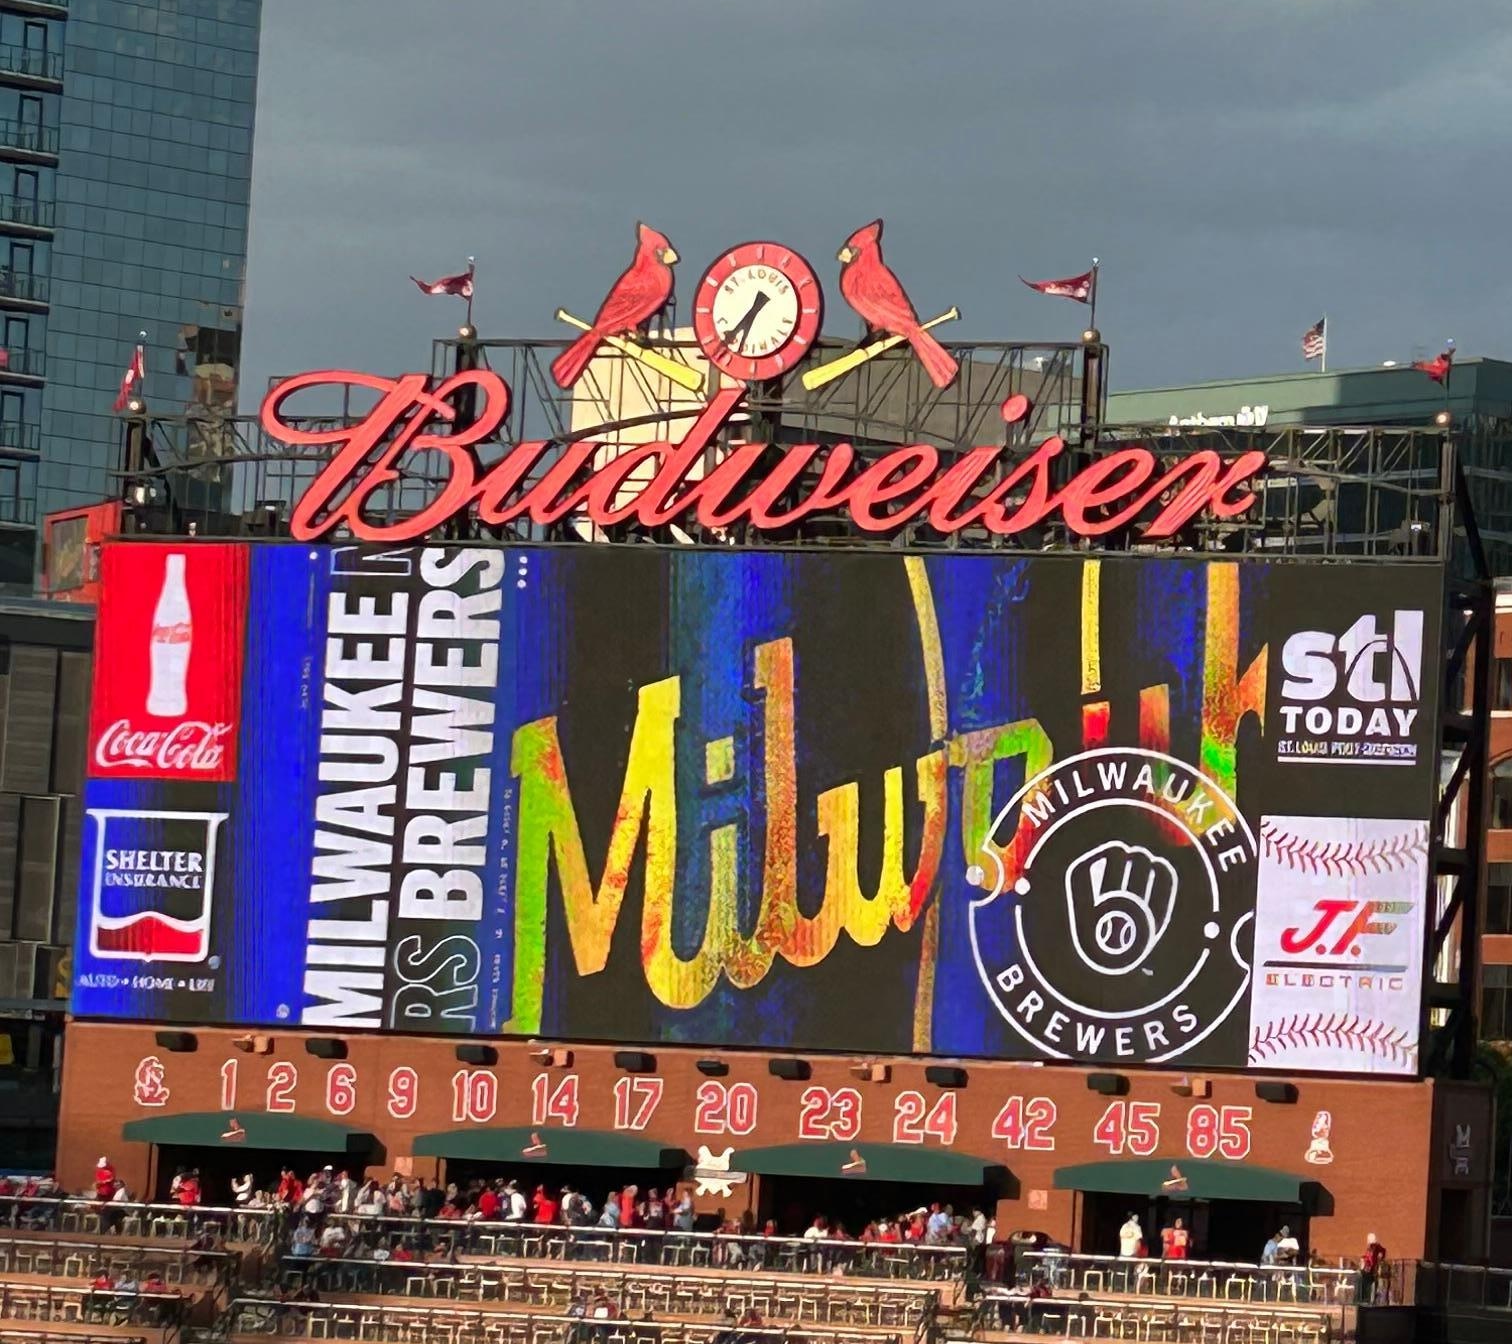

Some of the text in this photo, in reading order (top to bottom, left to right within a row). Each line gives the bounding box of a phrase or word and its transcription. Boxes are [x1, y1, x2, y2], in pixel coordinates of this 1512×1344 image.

[259, 369, 1270, 542] Budweiser
[1281, 610, 1425, 703] stl
[95, 718, 234, 771] Coca-Cola
[397, 547, 505, 922] BREWERS
[1279, 705, 1419, 738] TODAY
[300, 592, 410, 1029] MILWAUKEE
[1020, 761, 1248, 873] MILWAUKEE
[105, 848, 204, 874] SHELTER
[995, 963, 1198, 1057] BREWERS
[1265, 972, 1404, 992] ELECTRIC
[219, 1058, 1253, 1160] 1 2 6 9 10 14 17 20 23 24 42 45 85
